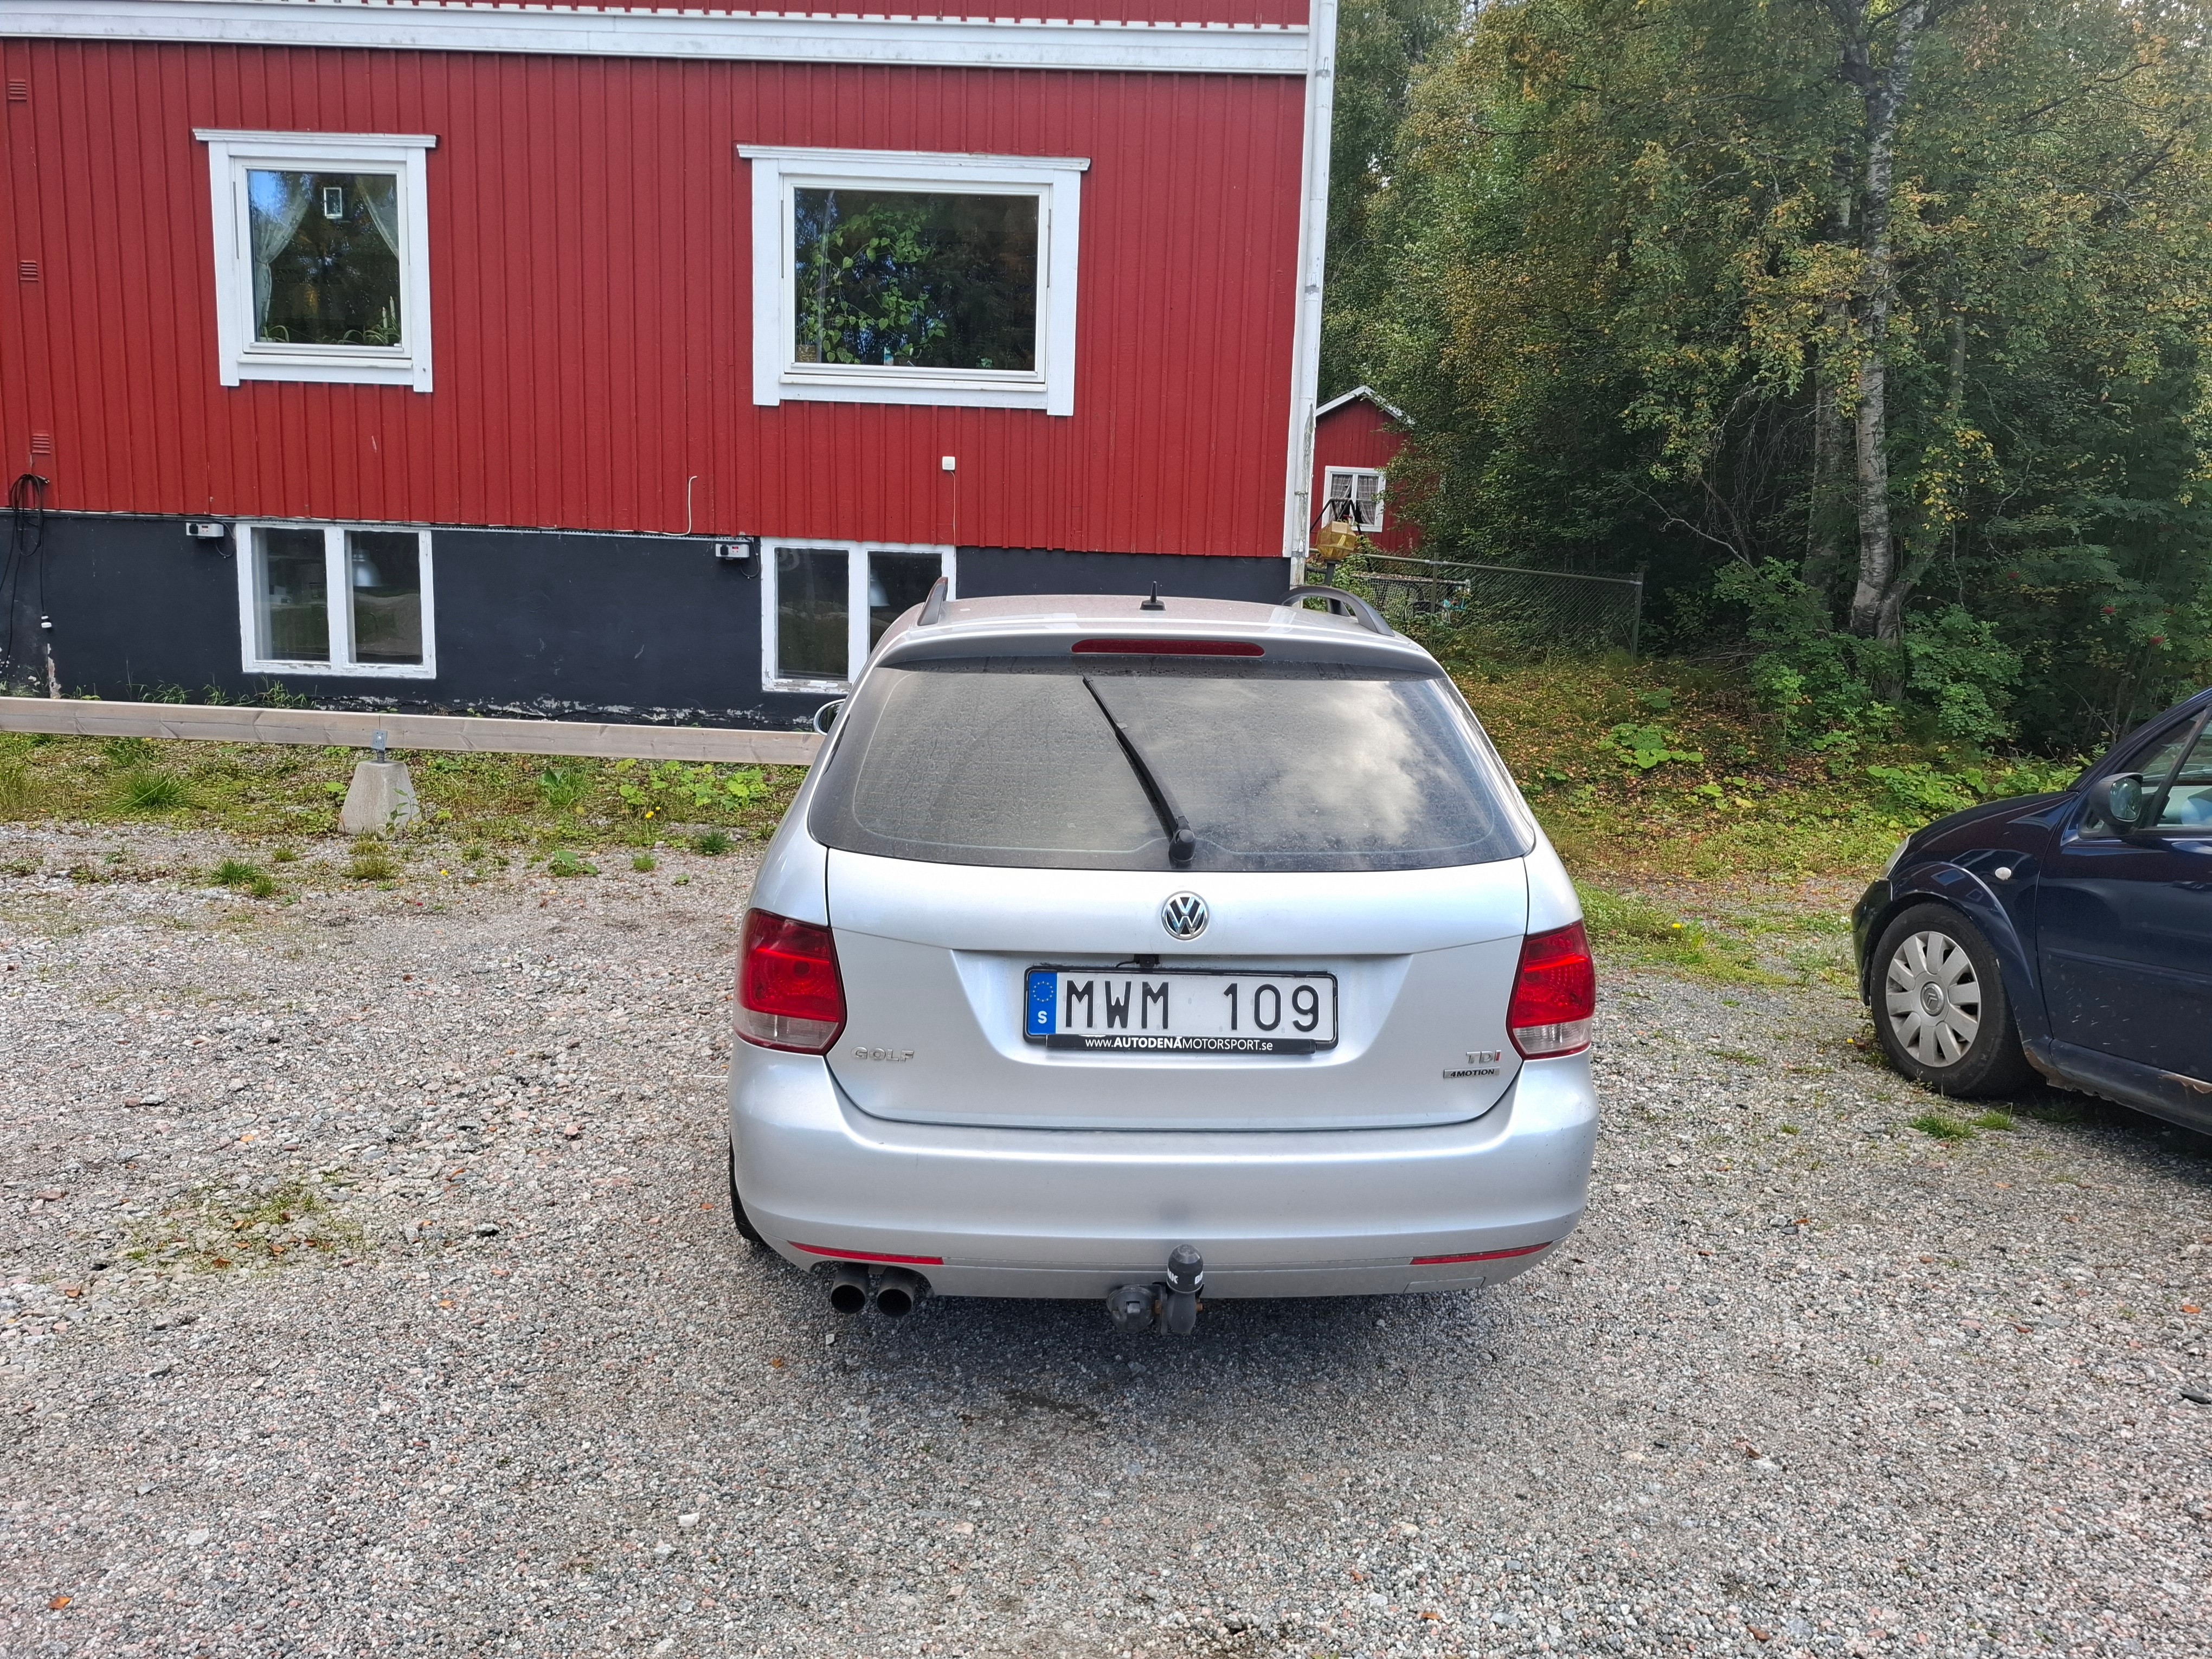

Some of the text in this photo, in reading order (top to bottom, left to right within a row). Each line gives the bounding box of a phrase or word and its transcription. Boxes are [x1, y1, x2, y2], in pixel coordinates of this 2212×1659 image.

[1065, 980, 1319, 1032] MWM 109
[1037, 1011, 1047, 1024] S
[850, 1046, 915, 1063] GOLF
[1465, 1050, 1501, 1064] TDI
[1450, 1069, 1495, 1077] 4MOTION
